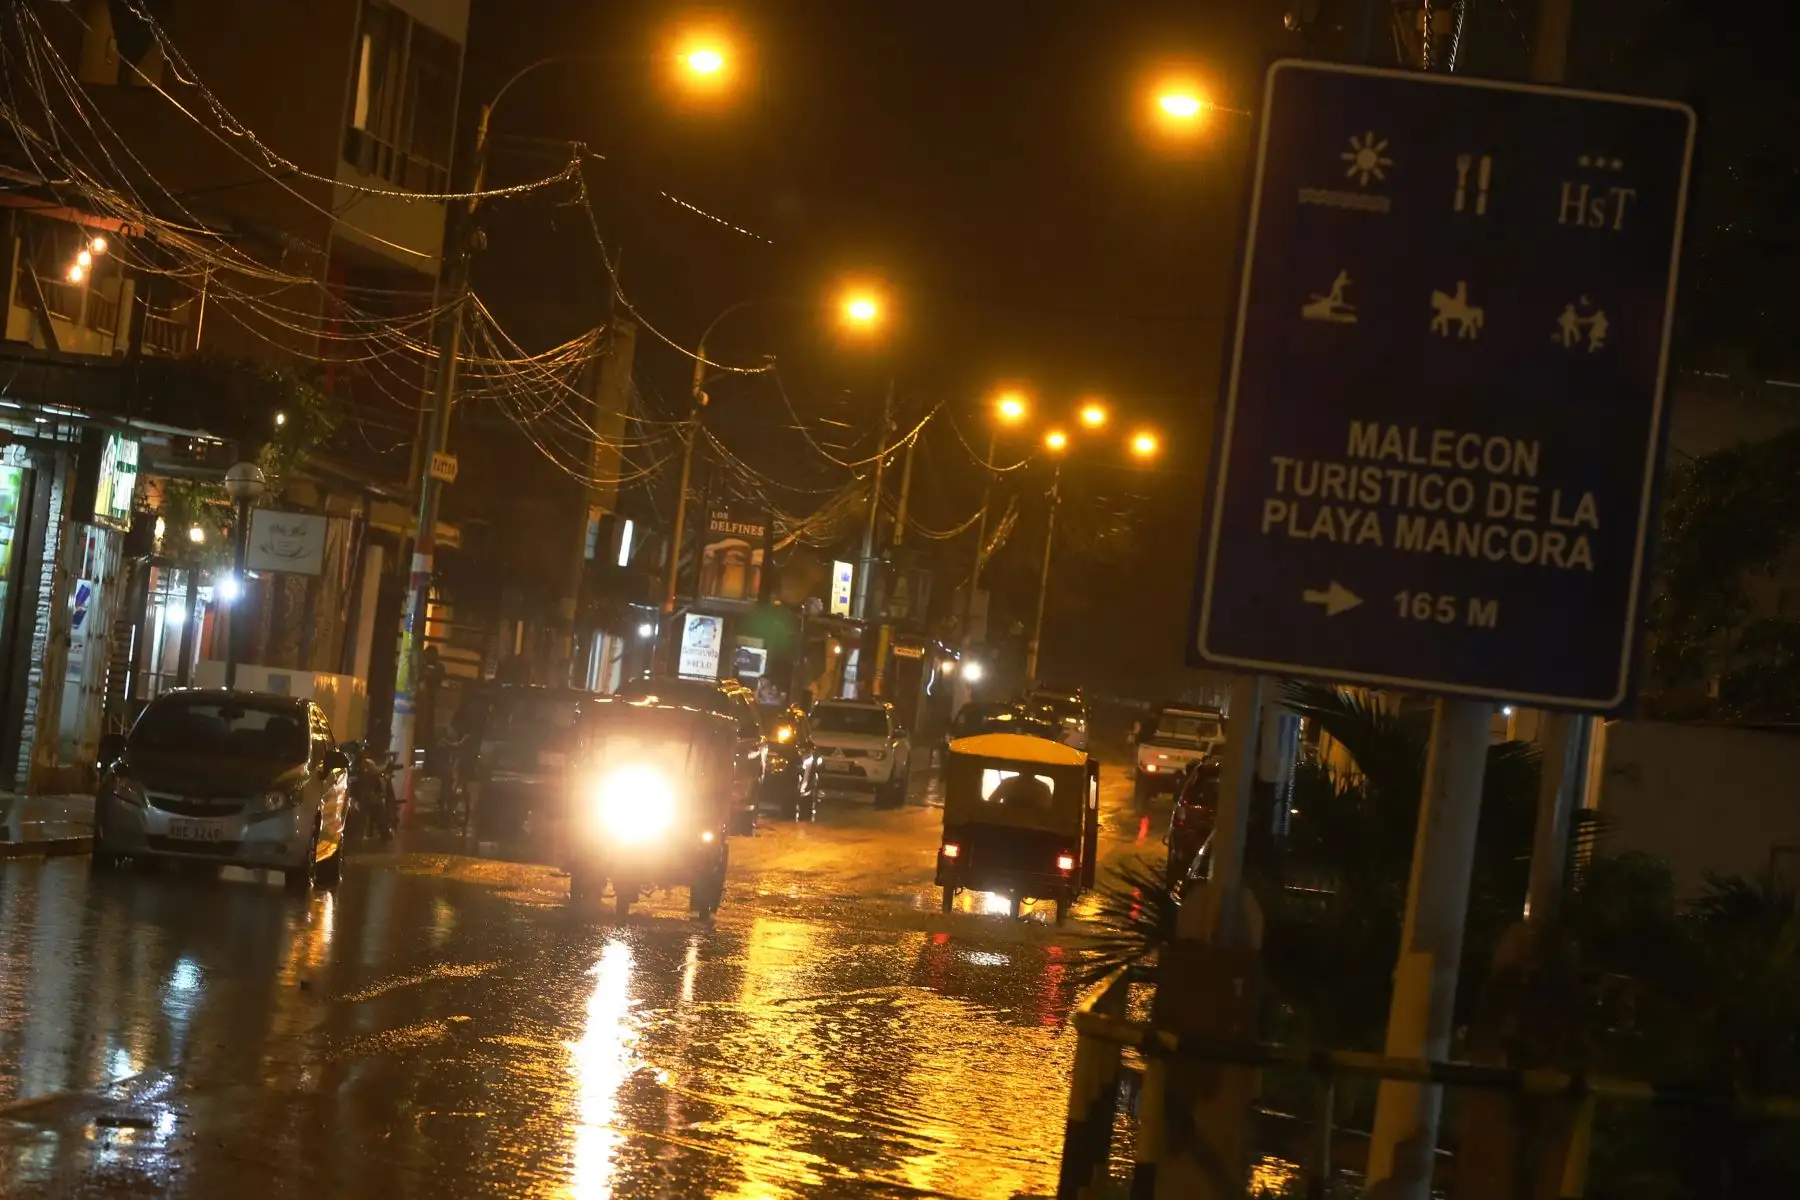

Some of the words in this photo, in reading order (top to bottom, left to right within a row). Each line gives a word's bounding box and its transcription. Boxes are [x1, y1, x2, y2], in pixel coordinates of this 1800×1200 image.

[1347, 420, 1540, 477] MALECON
[712, 511, 728, 519] LOS
[1271, 456, 1475, 514] TURISTICO
[1486, 481, 1540, 522] DE
[1549, 489, 1599, 530] LA
[710, 520, 764, 536] DELFINES
[1261, 499, 1384, 547] PLAYA
[1394, 513, 1594, 571] MANCORA
[1394, 590, 1456, 624] 165
[1467, 597, 1499, 628] M
